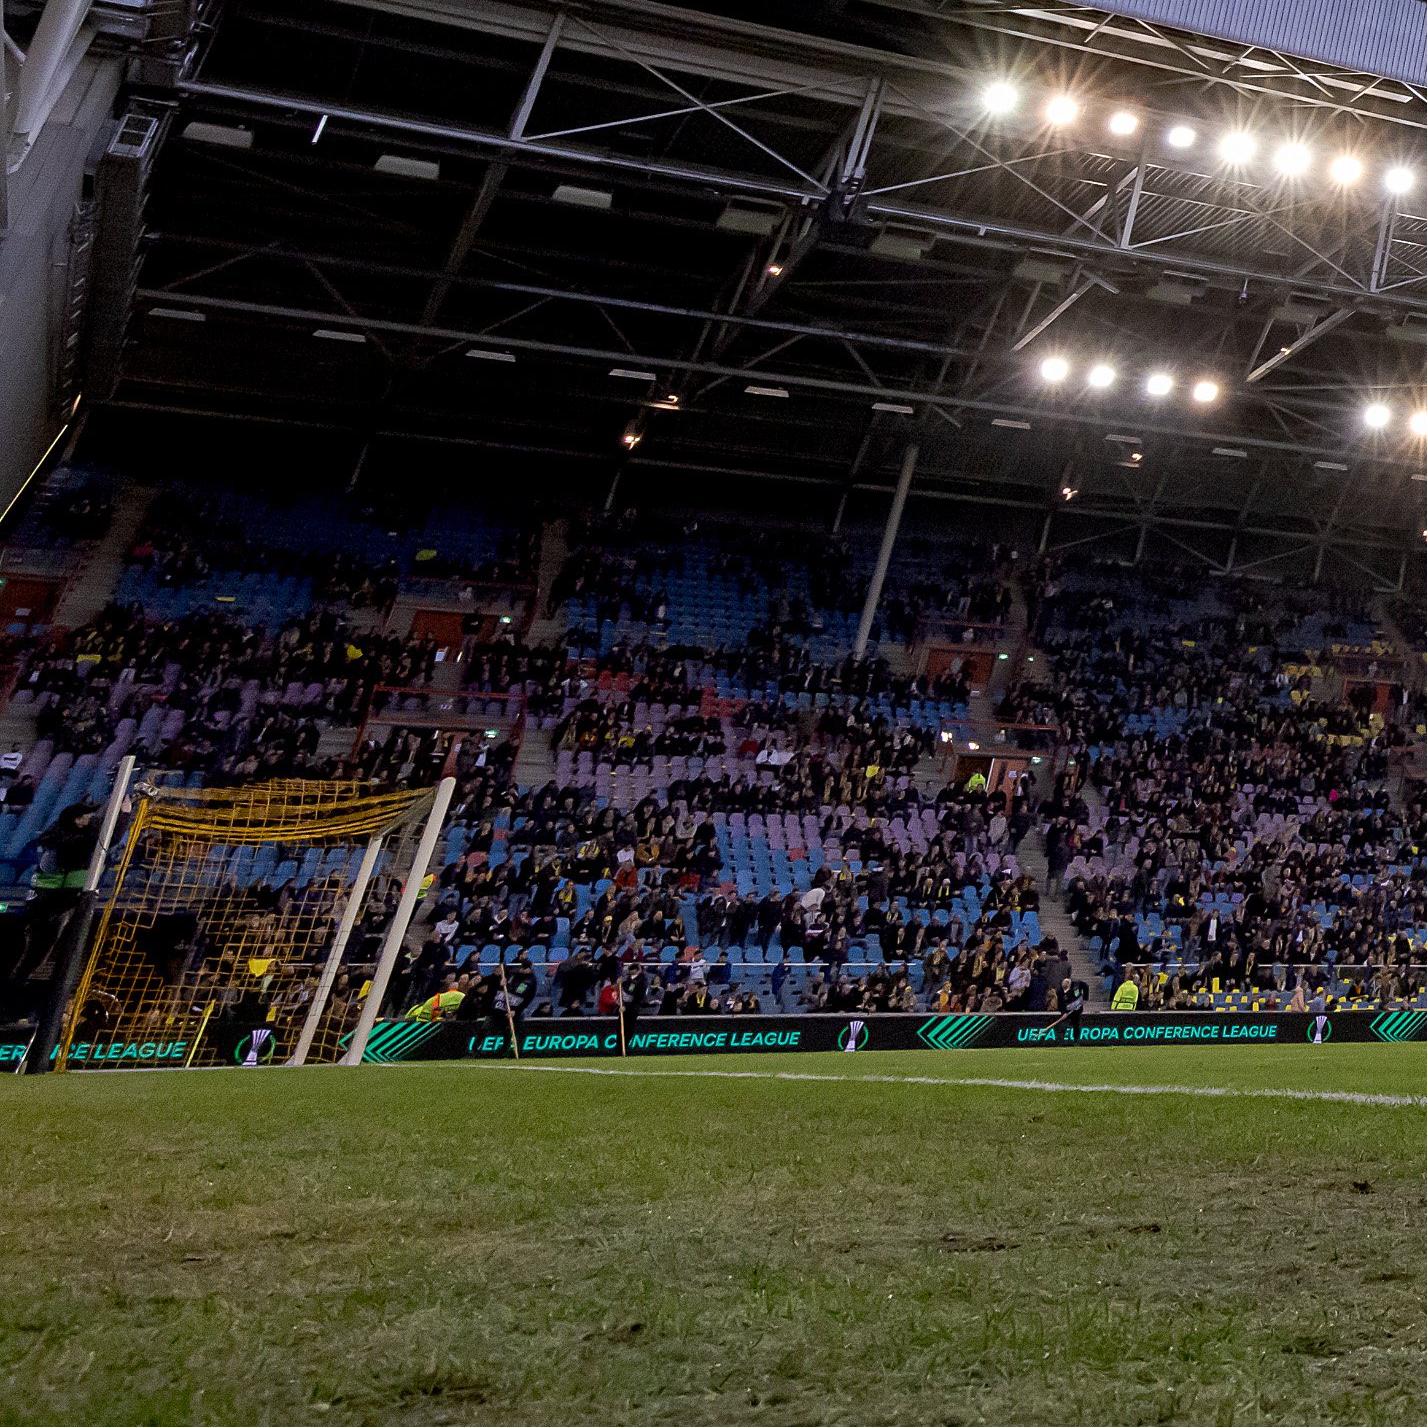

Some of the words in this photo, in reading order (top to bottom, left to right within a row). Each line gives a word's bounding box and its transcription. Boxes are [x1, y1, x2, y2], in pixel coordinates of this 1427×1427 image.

[523, 1034, 598, 1050] EUROPA
[604, 1032, 727, 1050] CNFERENCE
[730, 1031, 801, 1047] LEAGUE
[1017, 1027, 1056, 1041] UEFA
[1123, 1024, 1220, 1039] CONFERENCE
[1222, 1023, 1278, 1038] LEAGUE
[93, 1041, 187, 1060] LEAGUE
